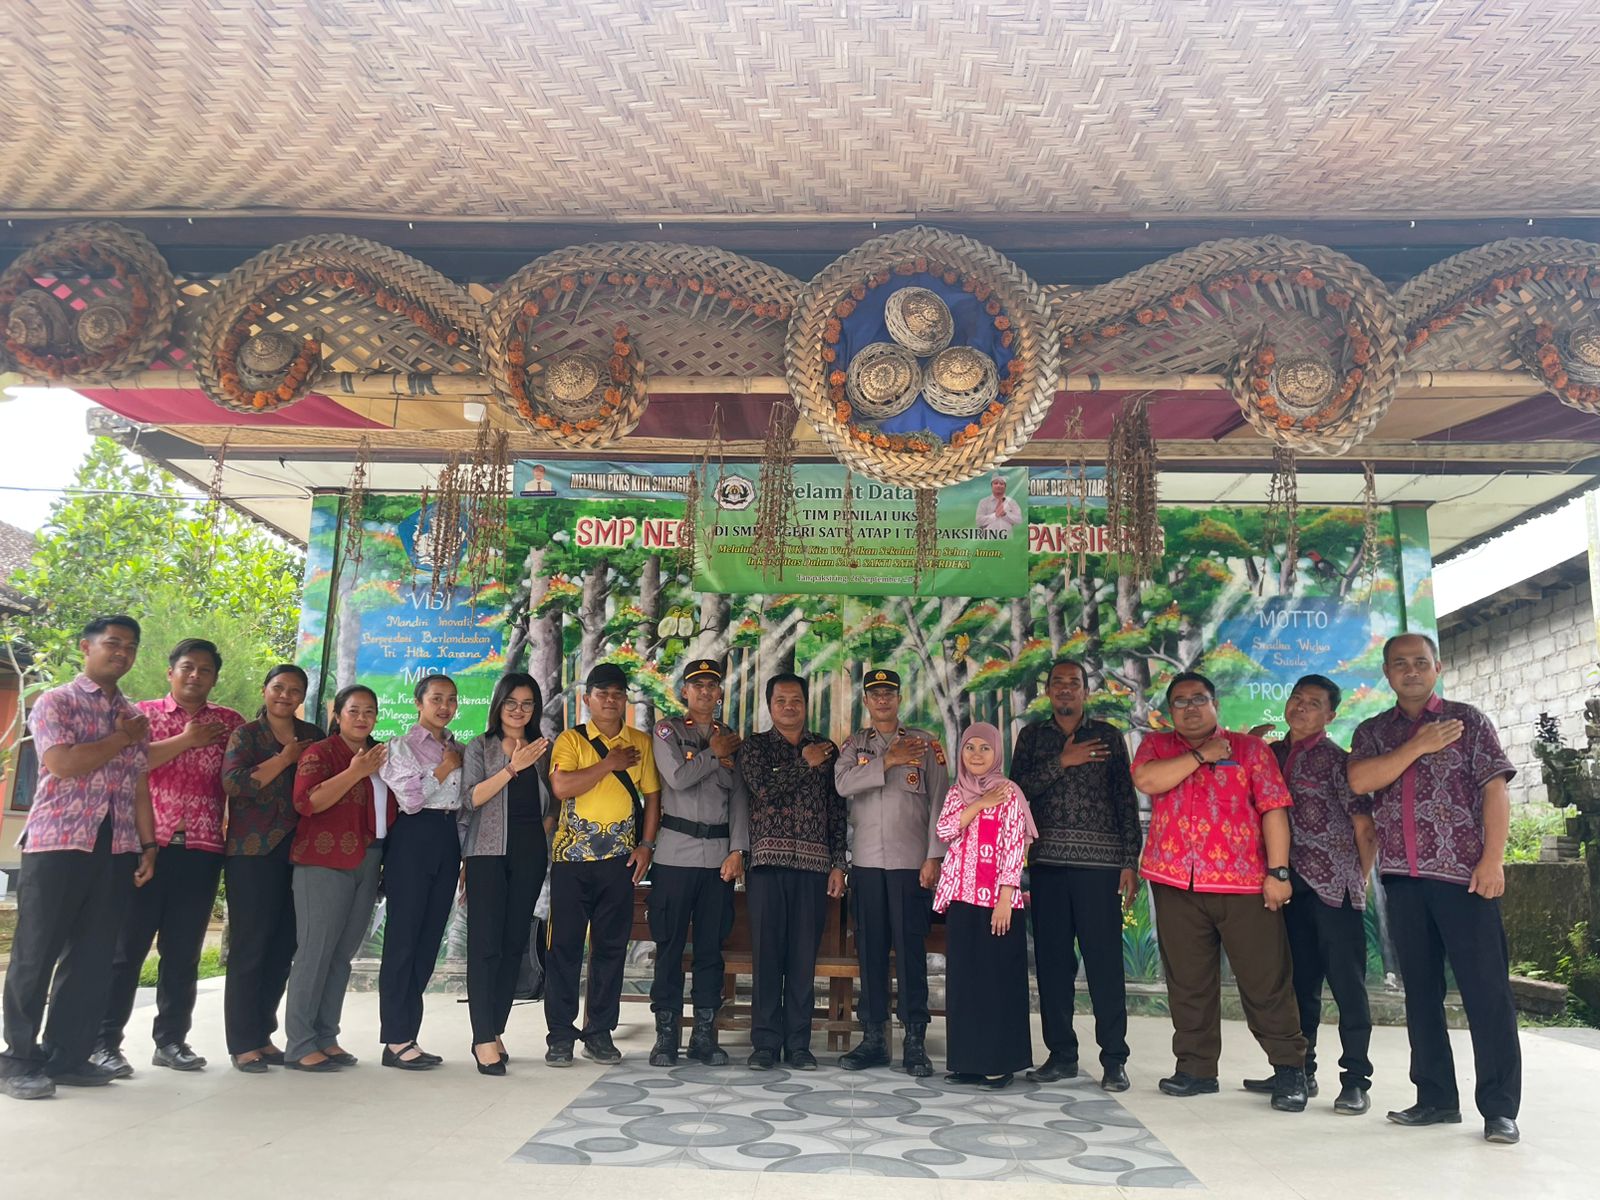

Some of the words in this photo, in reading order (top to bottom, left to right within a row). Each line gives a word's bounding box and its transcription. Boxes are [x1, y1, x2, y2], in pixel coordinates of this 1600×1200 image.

[571, 473, 606, 489] MELALUI
[607, 474, 630, 491] PKKS
[631, 475, 650, 492] KITA
[1028, 479, 1050, 496] OME
[868, 484, 938, 506] Data
[803, 510, 828, 521] TIM
[833, 510, 887, 522] PENILAI
[892, 511, 918, 522] UKS
[577, 519, 635, 546] SMP
[715, 526, 728, 537] DI
[767, 526, 814, 538] EGERI
[857, 527, 891, 539] ATAP
[903, 527, 1008, 540] TAPAKSIRING
[386, 615, 429, 628] Mandiri
[1256, 609, 1328, 629] MOTTO
[421, 631, 490, 643] Berlandaskan
[381, 645, 397, 658] Tri
[404, 645, 432, 658] Hita
[437, 646, 481, 658] Karana
